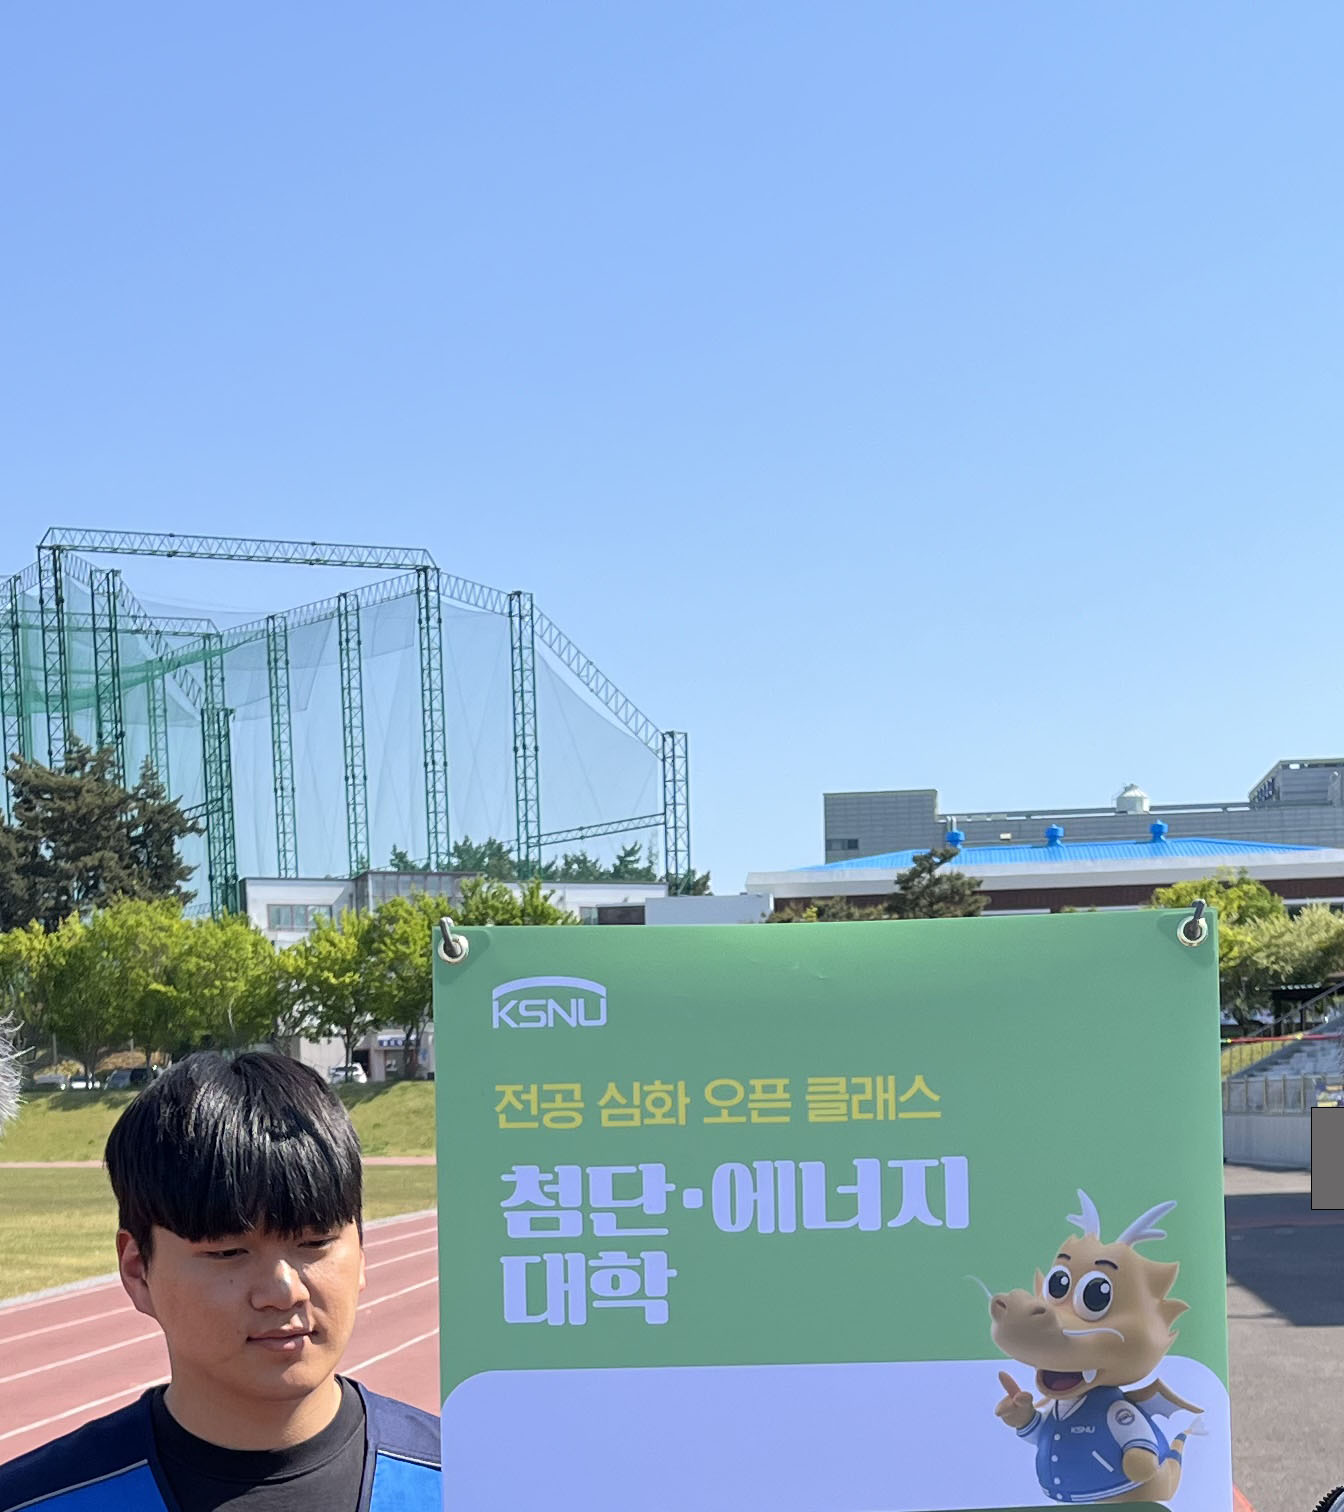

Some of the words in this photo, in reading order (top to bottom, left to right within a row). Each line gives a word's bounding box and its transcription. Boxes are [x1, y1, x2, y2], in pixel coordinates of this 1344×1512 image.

[492, 976, 607, 1029] KSNU
[494, 1083, 584, 1129] 전공
[598, 1081, 690, 1127] 심화
[702, 1078, 791, 1124] 오픈
[806, 1074, 942, 1122] 클래스
[500, 1155, 970, 1239] 첨단·에너지
[499, 1251, 678, 1326] 대학
